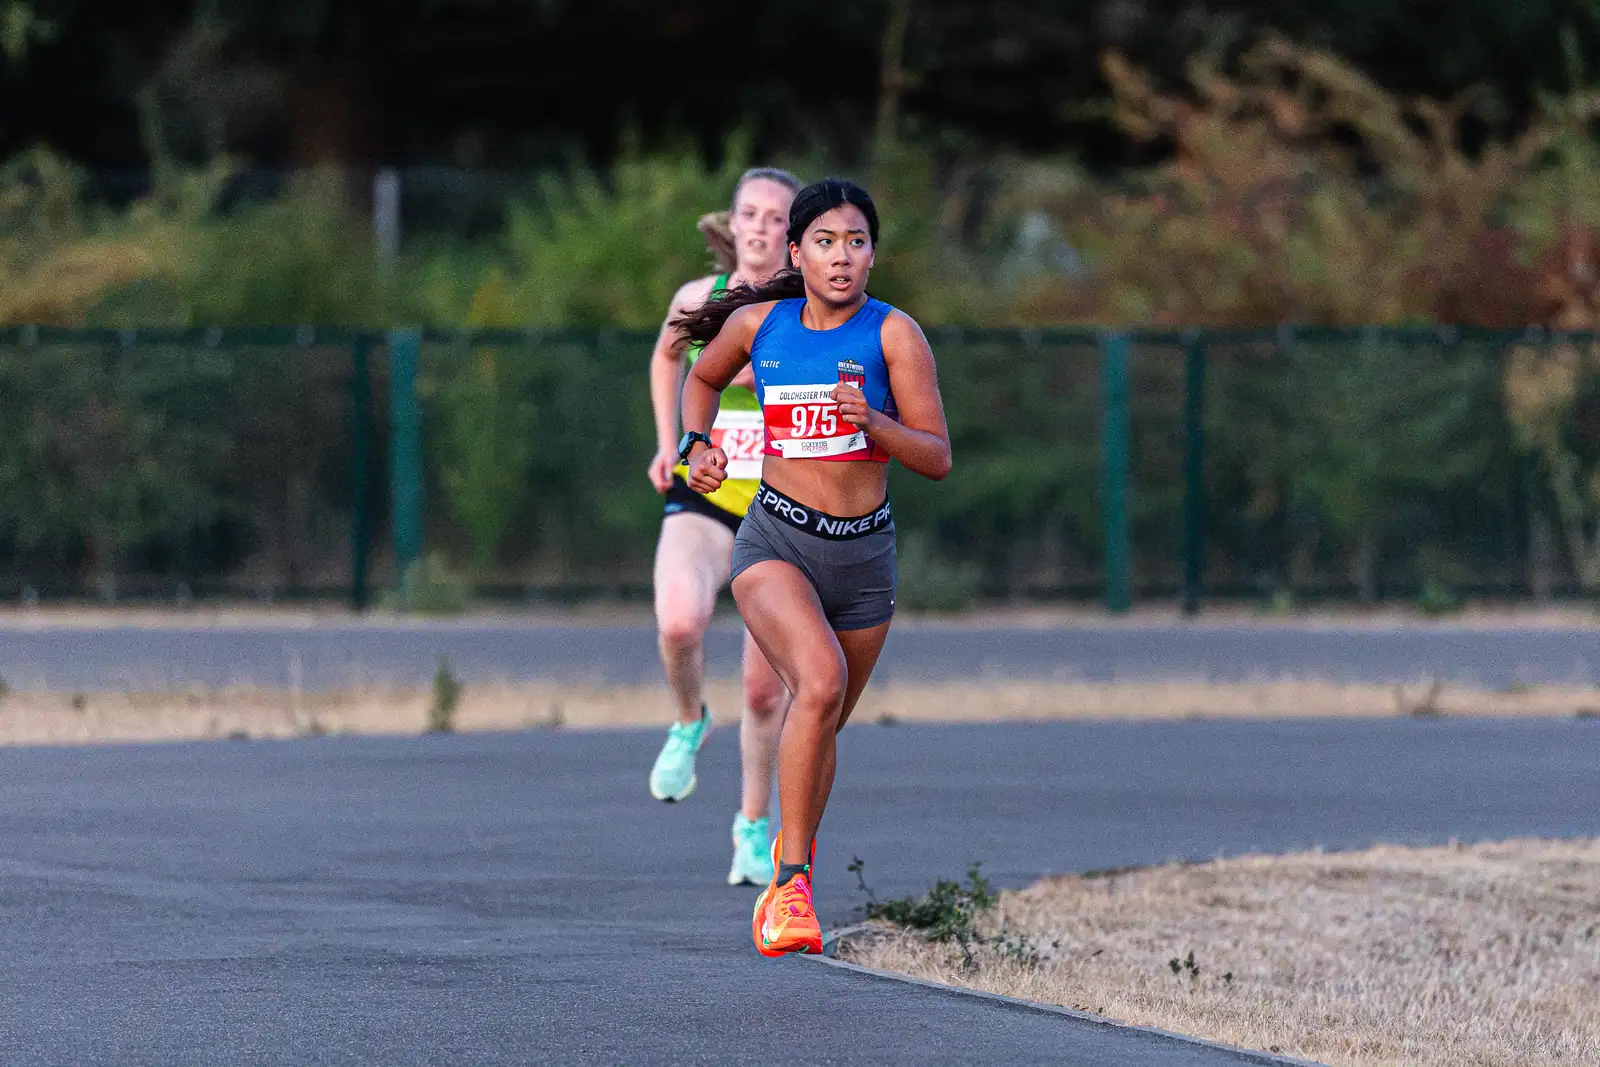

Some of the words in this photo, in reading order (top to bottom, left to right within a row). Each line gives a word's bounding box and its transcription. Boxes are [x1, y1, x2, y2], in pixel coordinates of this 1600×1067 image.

[780, 391, 818, 400] COLCHESTER
[790, 405, 838, 438] 975
[762, 490, 808, 525] PRO
[816, 515, 873, 535] NIKE
[874, 502, 890, 527] PR
